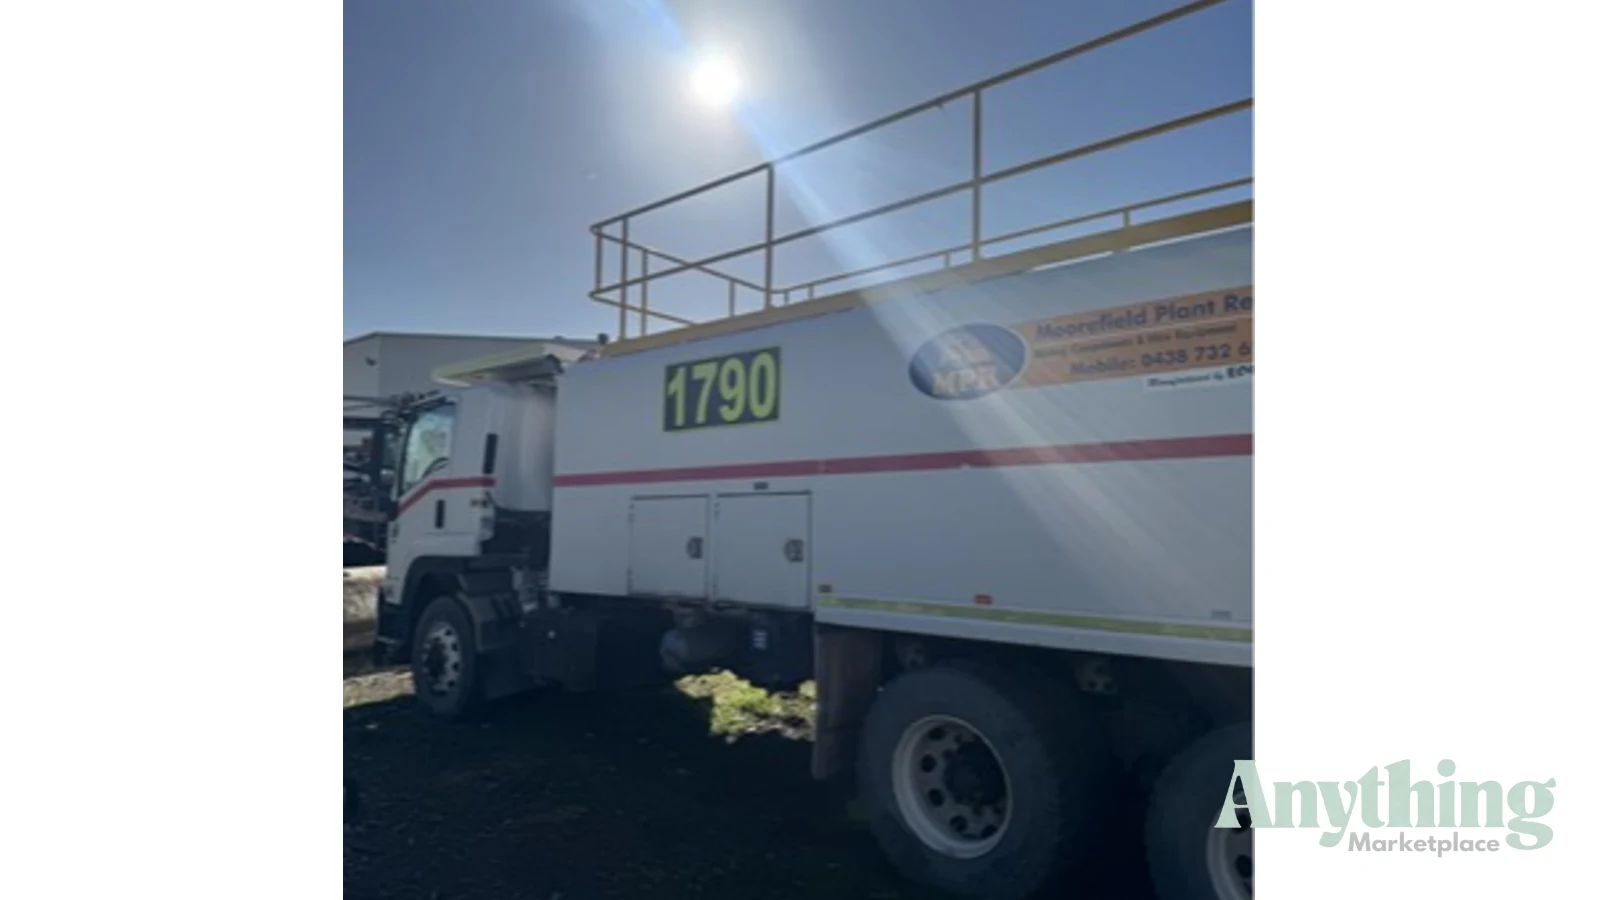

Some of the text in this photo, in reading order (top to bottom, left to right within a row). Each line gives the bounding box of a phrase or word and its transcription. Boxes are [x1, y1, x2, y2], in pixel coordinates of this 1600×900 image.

[1036, 311, 1147, 341] Moorefield
[1155, 298, 1214, 323] Plant
[1141, 347, 1188, 369] 0438
[1194, 342, 1232, 362] 732
[667, 351, 776, 427] 1790
